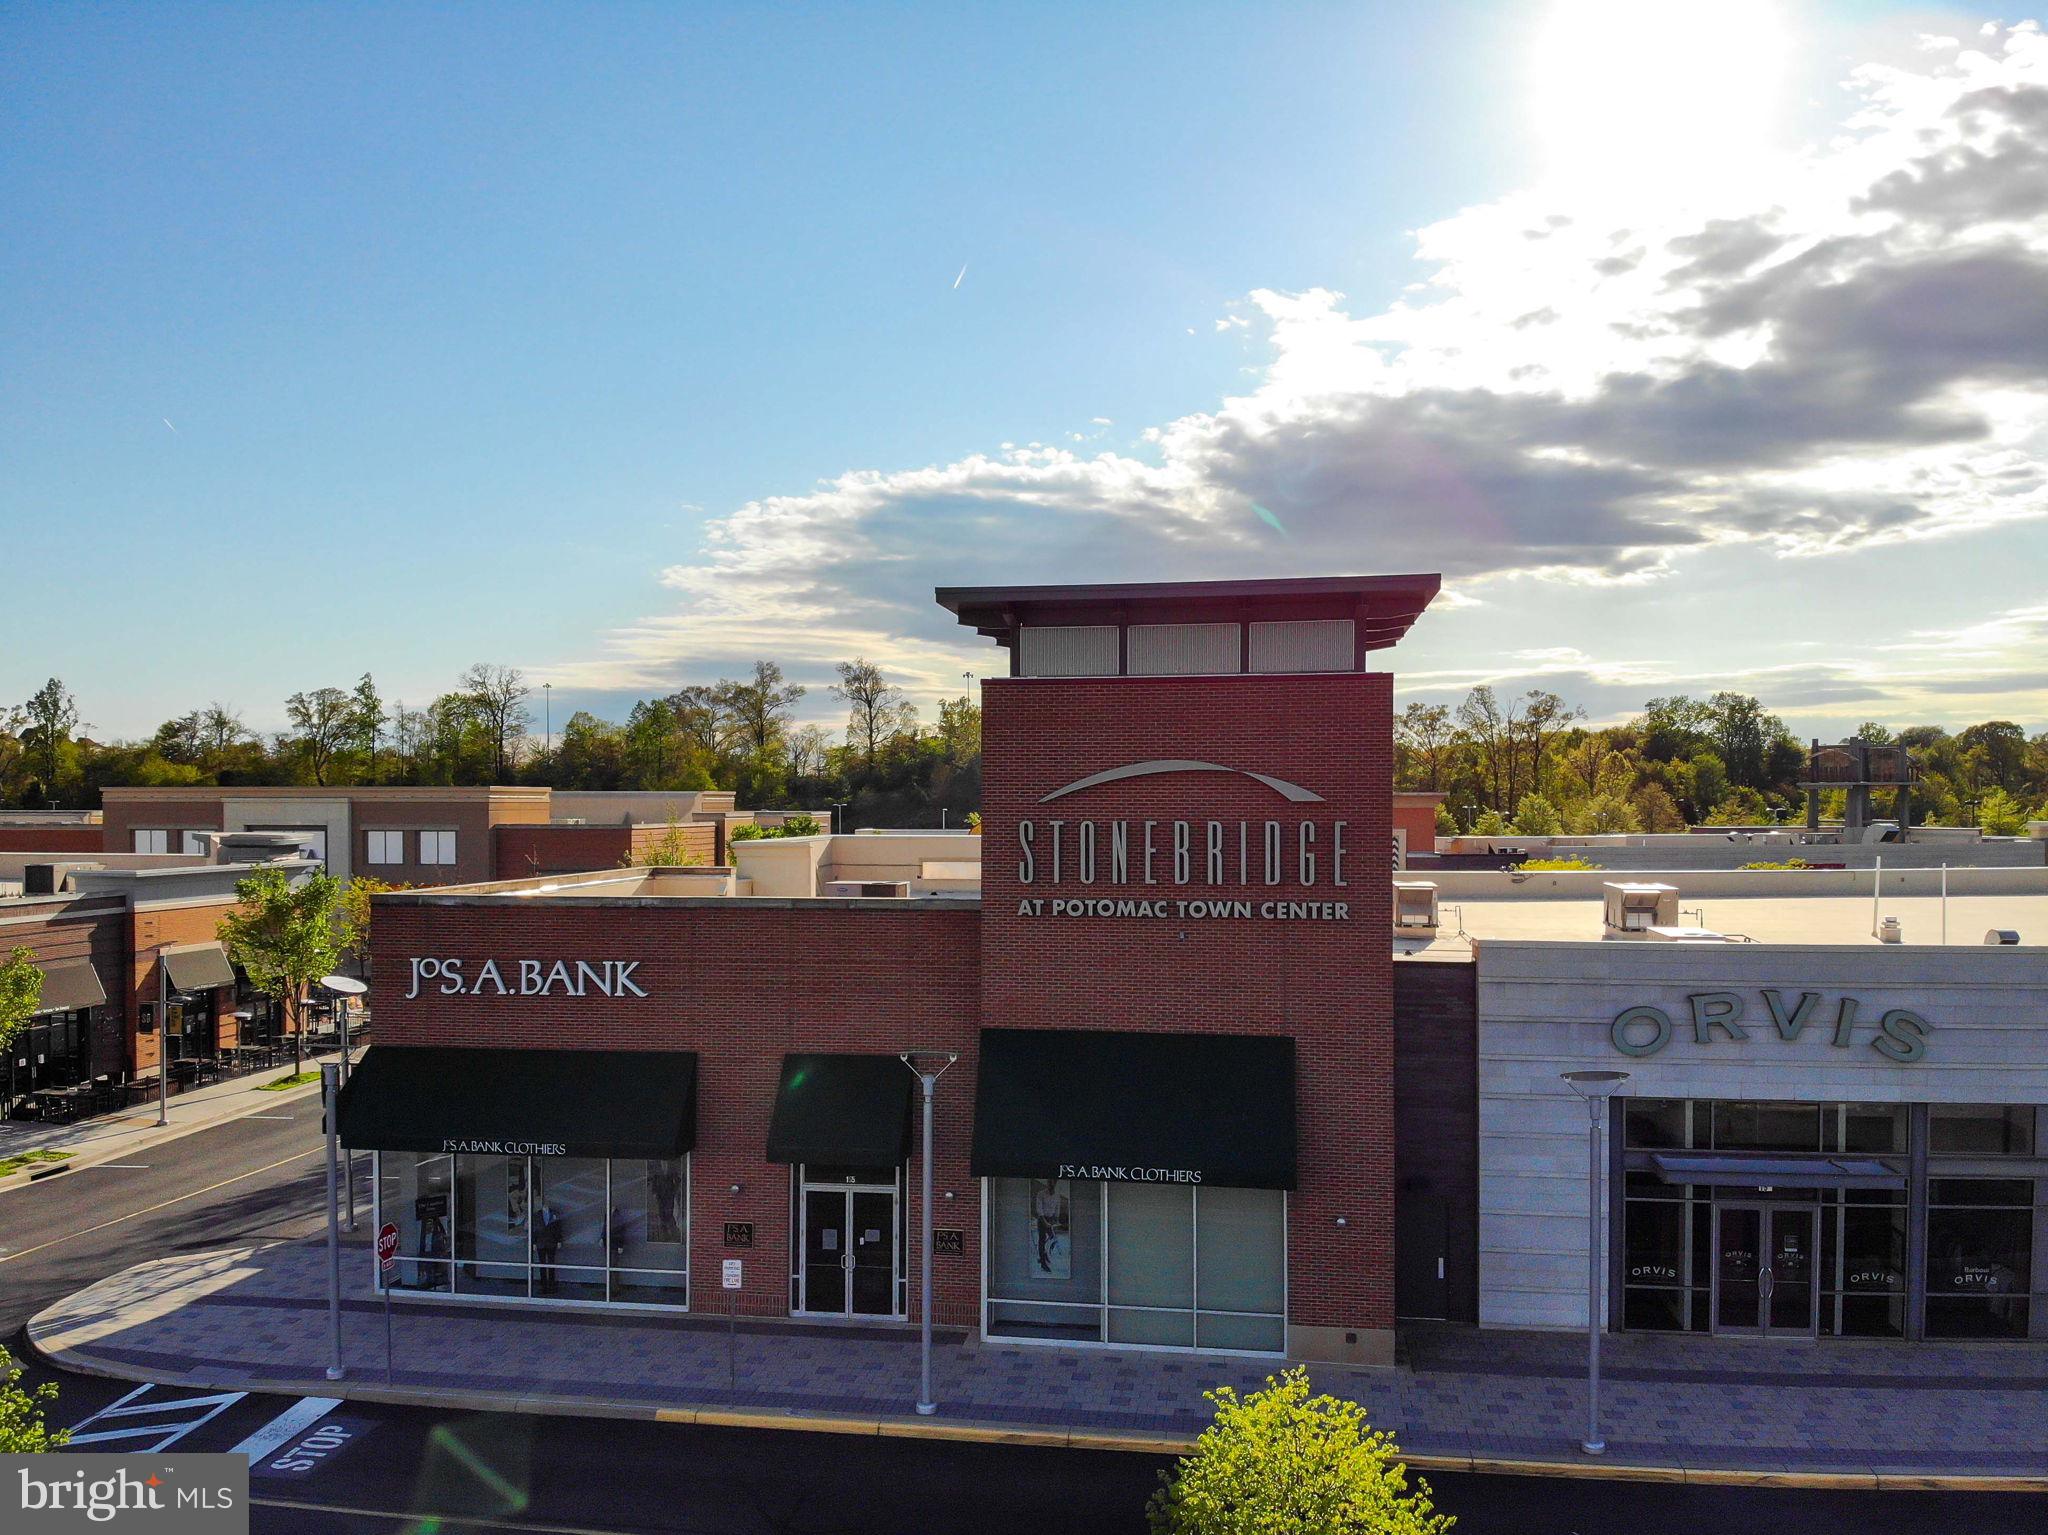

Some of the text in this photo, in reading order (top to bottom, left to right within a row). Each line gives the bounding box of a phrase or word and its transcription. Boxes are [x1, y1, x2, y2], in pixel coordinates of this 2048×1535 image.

[1018, 820, 1348, 887] STONEBRIDGE
[1017, 899, 1350, 920] AT POTOMAC TOWN CENTER
[1610, 989, 1934, 1063] ORVIS
[504, 1141, 567, 1155] CLOTHIERS
[1130, 1166, 1203, 1183] CLOTHIERS
[379, 1232, 397, 1252] STOP
[1632, 1266, 1677, 1278] ORVIS
[1850, 1272, 1896, 1284] ORVIS
[1954, 1274, 1998, 1285] ORVIS
[270, 1424, 353, 1472] STOP
